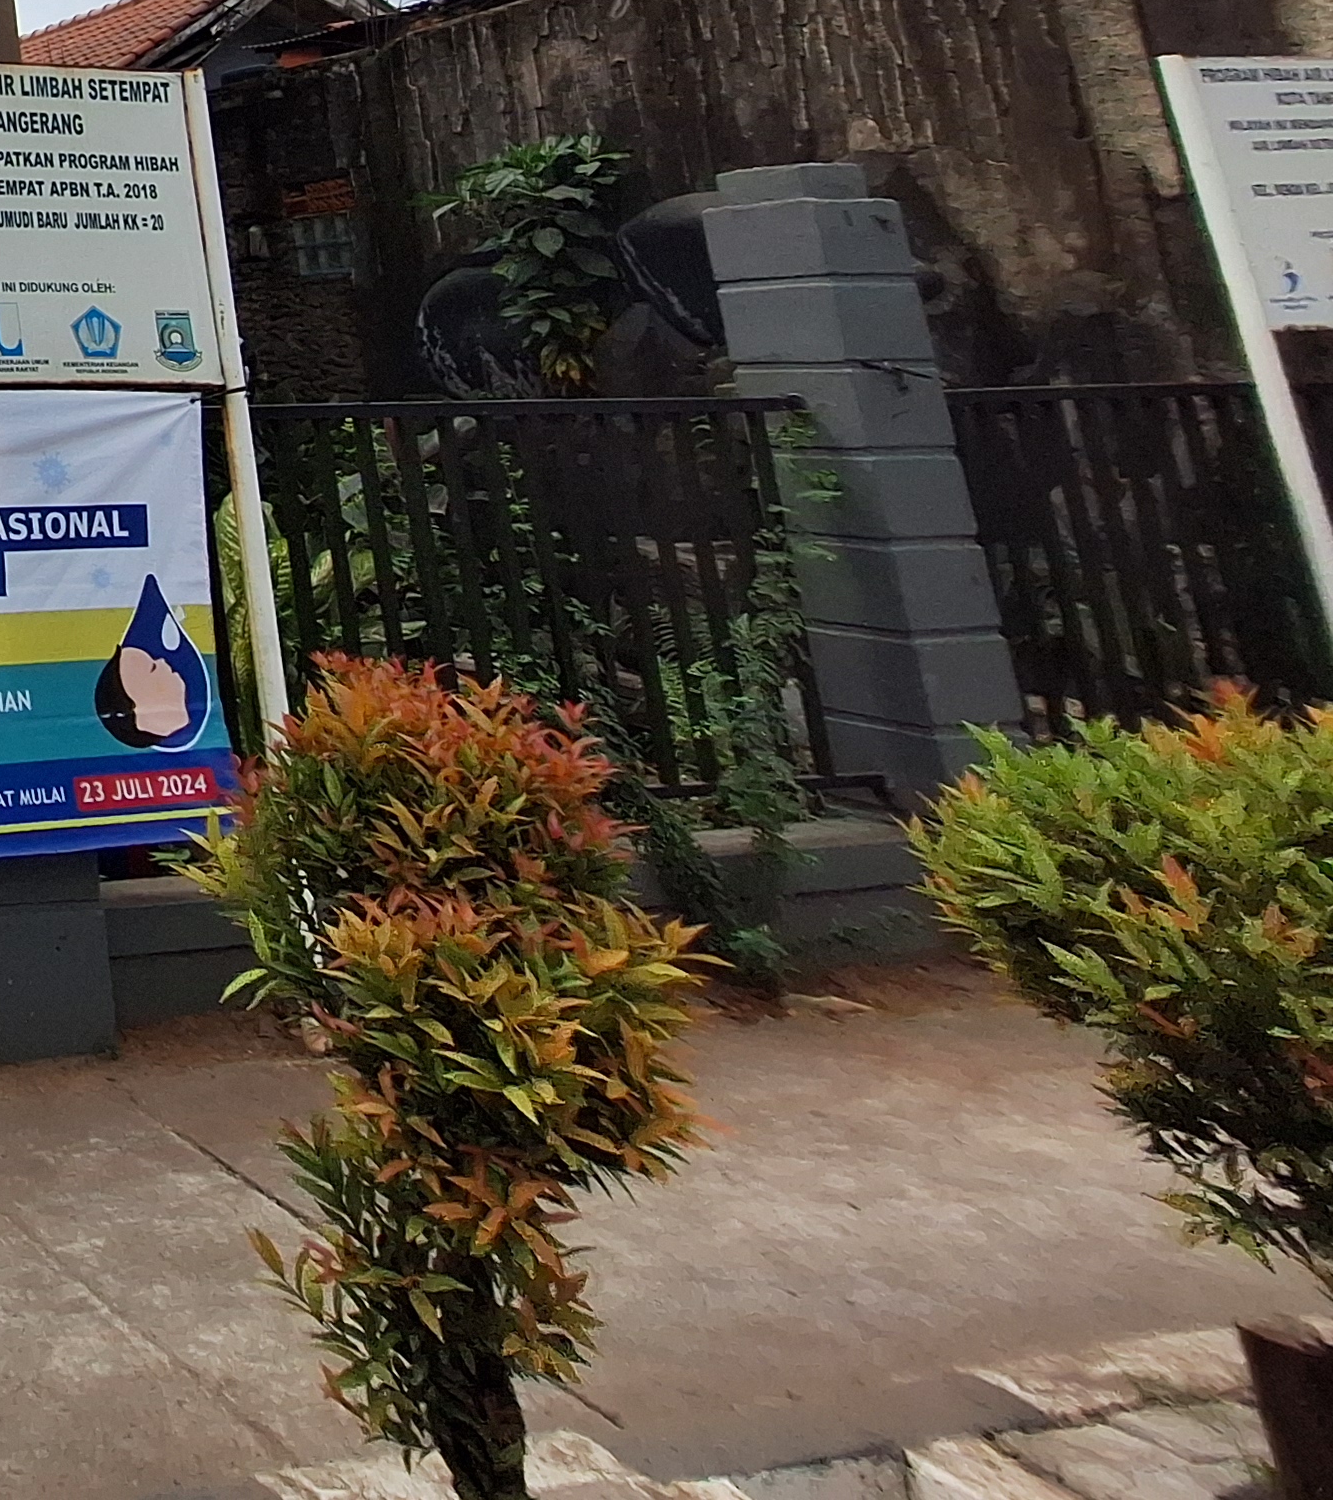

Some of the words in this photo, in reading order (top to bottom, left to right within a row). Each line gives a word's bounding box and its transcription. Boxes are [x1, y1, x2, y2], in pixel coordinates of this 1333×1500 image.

[20, 75, 83, 99] LIMBAH
[88, 79, 169, 103] SETEMPAT
[59, 153, 130, 170] PROGRAM
[134, 156, 179, 171] HIBAH
[50, 181, 90, 197] APBN
[94, 183, 120, 198] T.A.
[124, 184, 157, 199] 2018
[37, 212, 67, 228] BARU
[75, 213, 120, 229] JUMLAH
[123, 214, 139, 230] KK
[142, 218, 148, 228] =
[151, 215, 163, 230] 20
[2, 282, 16, 292] INI
[19, 282, 78, 292] DIDUKUNG
[82, 283, 115, 293] OLEH:
[20, 787, 65, 805] MULAI
[80, 782, 104, 802] 23
[112, 778, 153, 800] JULI
[158, 774, 206, 796] 2024
